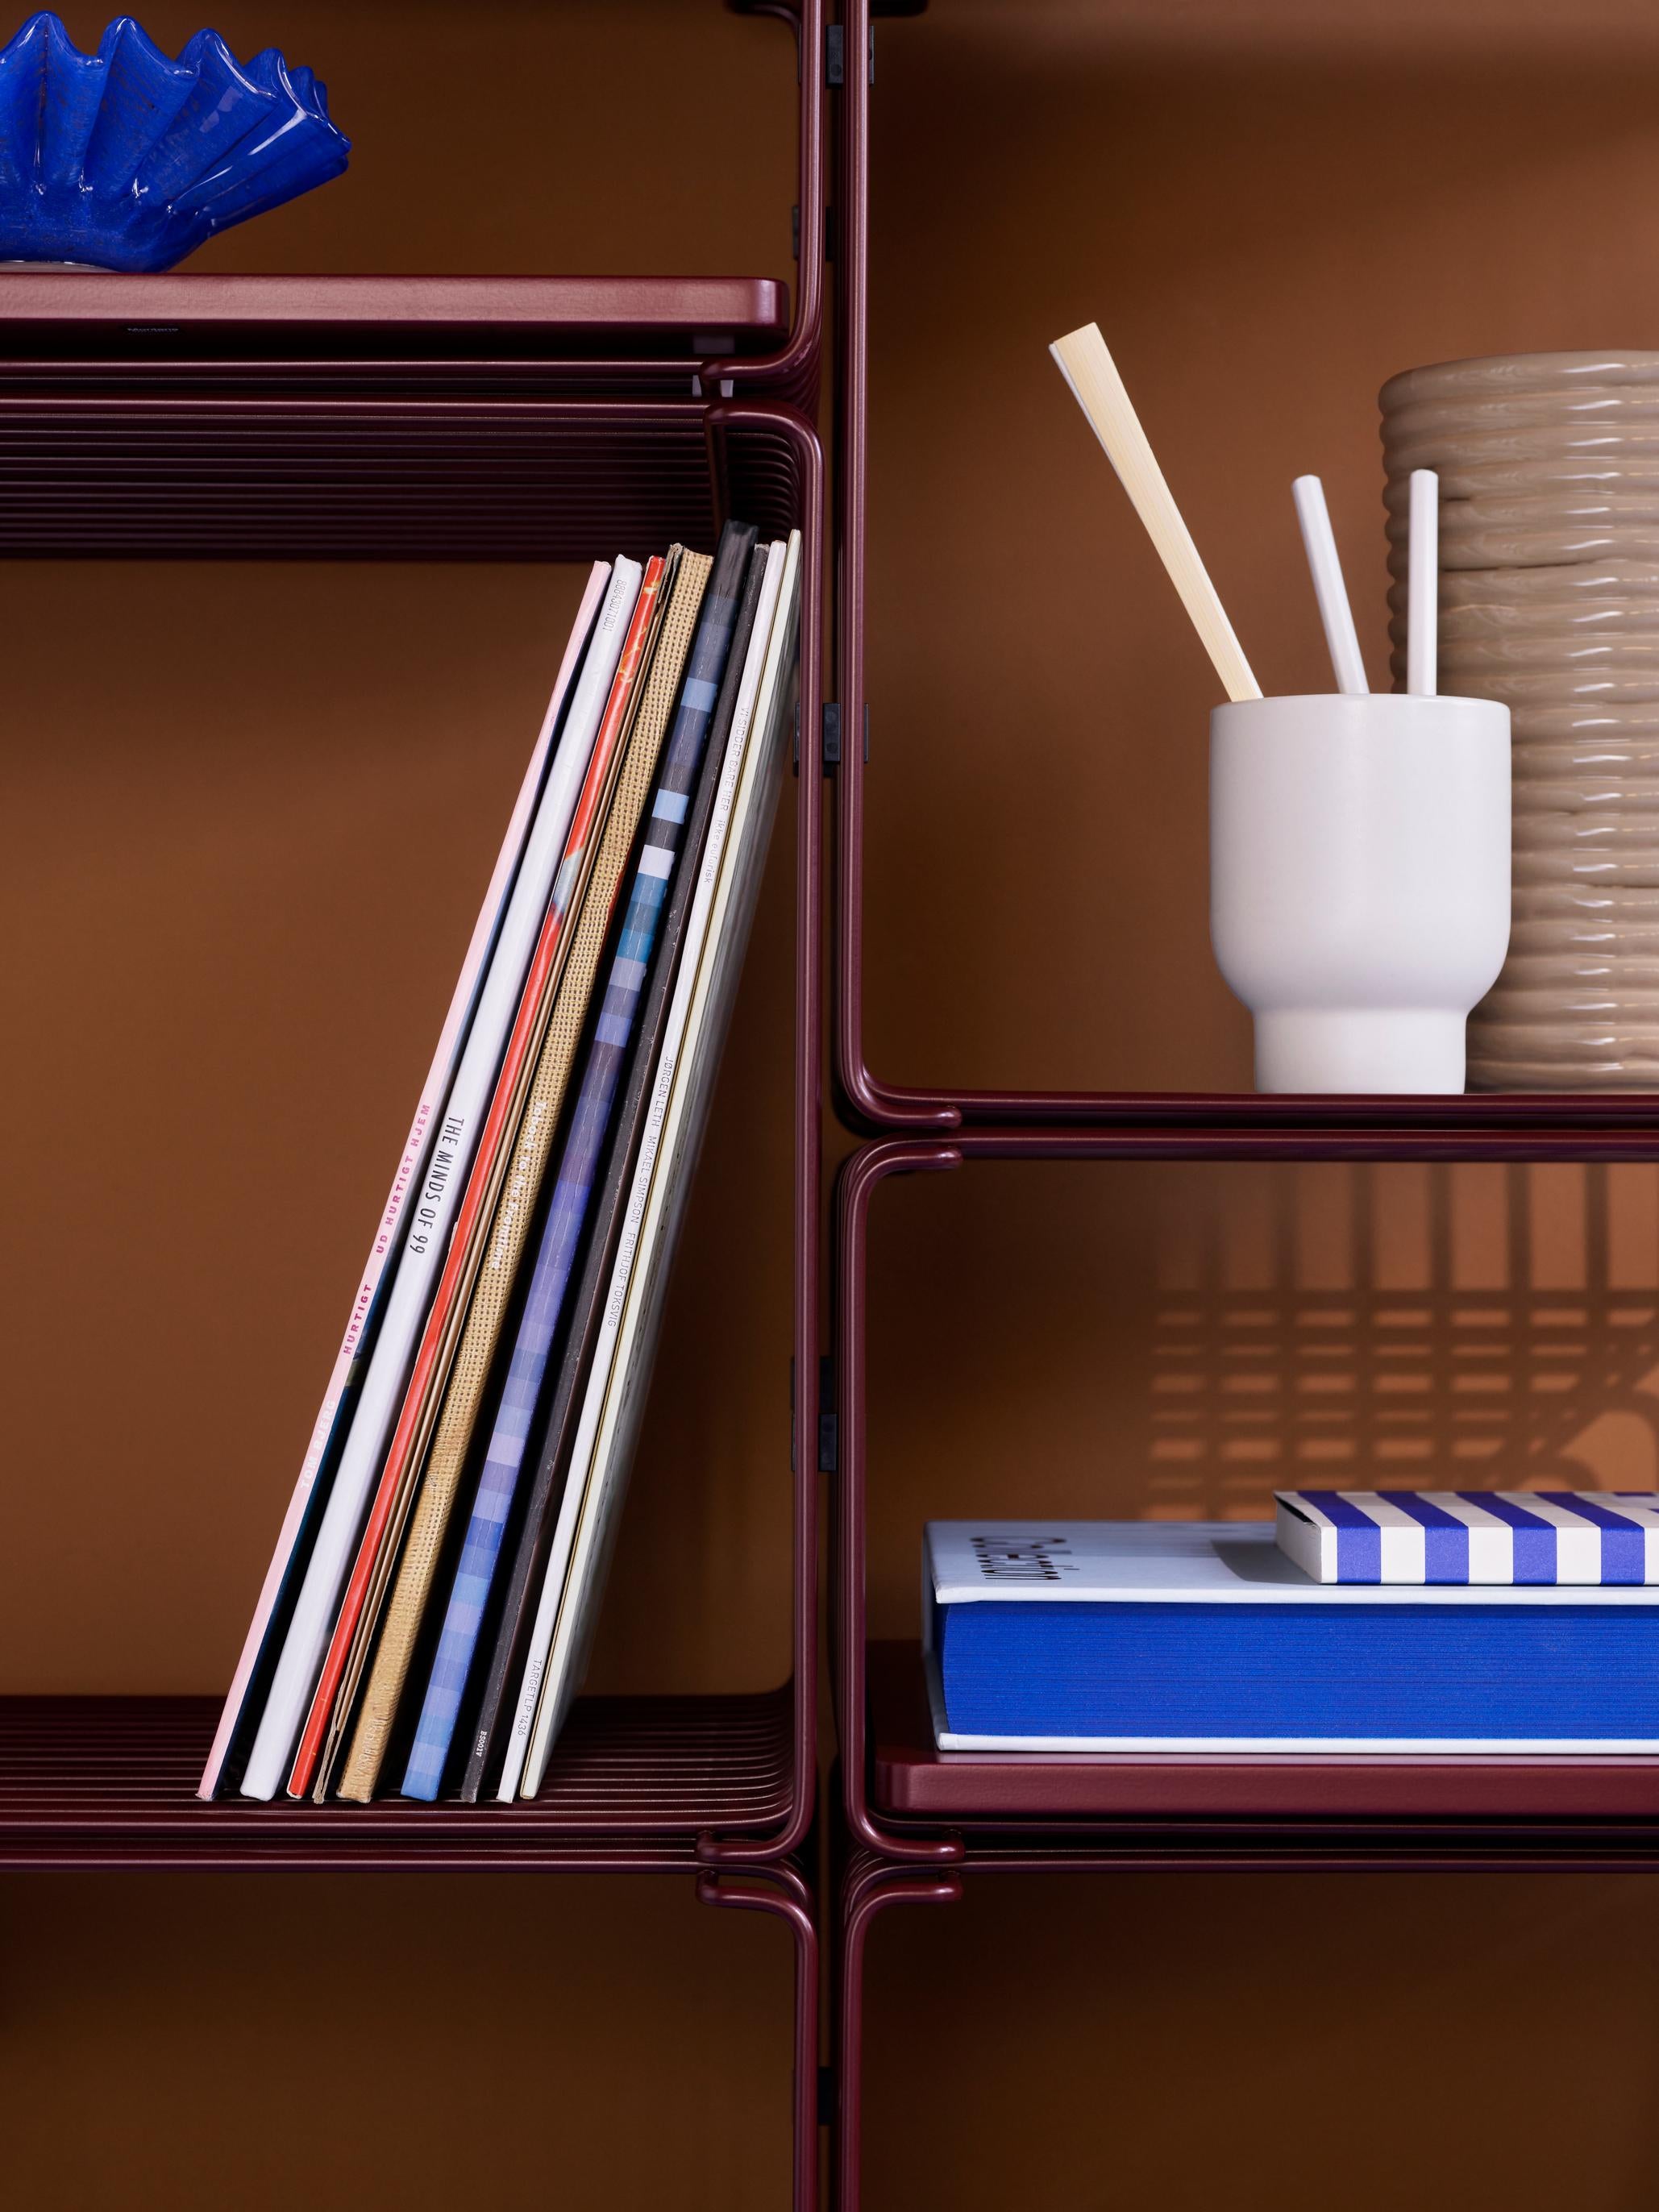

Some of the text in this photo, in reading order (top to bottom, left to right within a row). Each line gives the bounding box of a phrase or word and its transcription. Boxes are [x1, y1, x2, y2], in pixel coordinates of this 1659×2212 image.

[730, 718, 748, 757] SIDDER
[718, 789, 733, 812] HER
[651, 1056, 675, 1127] JØRGEN LETH
[410, 1116, 464, 1255] THE MINDS OF 99
[630, 1135, 658, 1224] MIKAEL SIMPSON
[343, 1104, 430, 1355] HURTIGT UD HURTIGT HJEM
[607, 1232, 636, 1328] FRITHJOF TOKSVIG
[301, 1399, 335, 1489] TOM BJERG
[475, 1730, 488, 1758] BS001V
